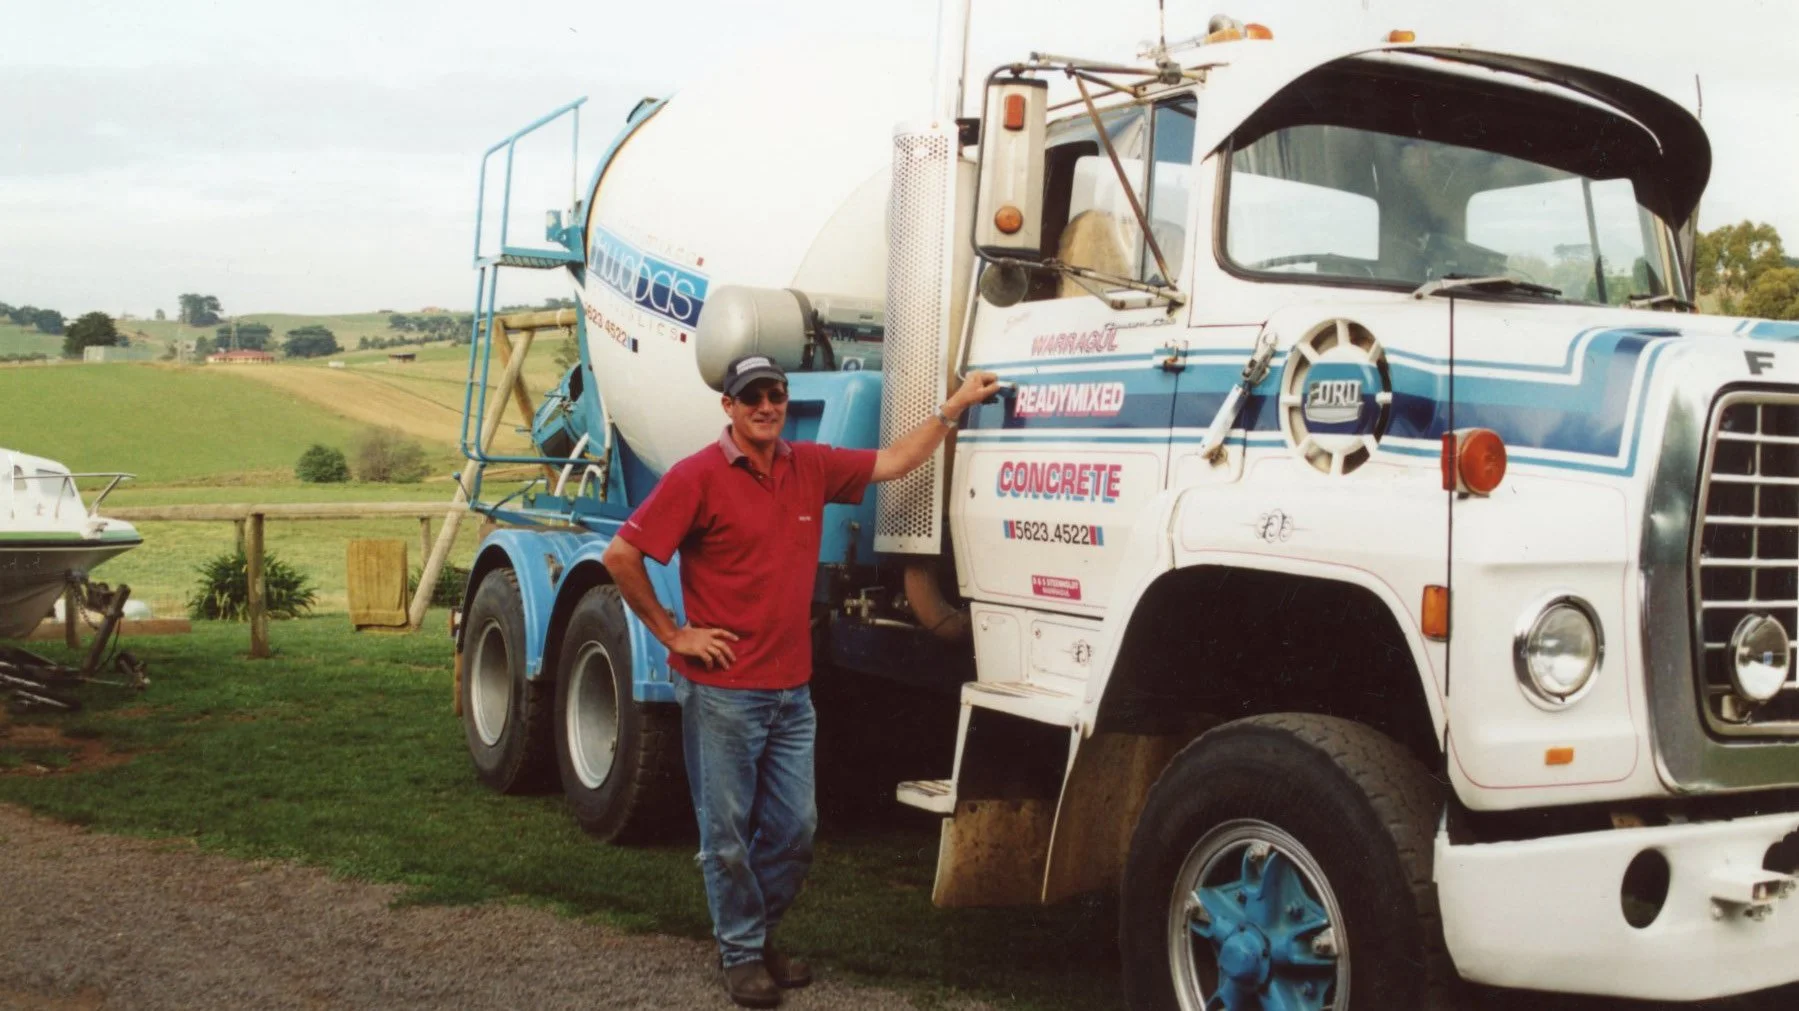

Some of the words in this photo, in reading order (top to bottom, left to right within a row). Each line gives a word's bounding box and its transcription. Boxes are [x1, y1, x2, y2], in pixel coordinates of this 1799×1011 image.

[1031, 329, 1119, 356] WARRAGUL
[1744, 350, 1775, 375] F
[1014, 382, 1124, 417] READYMIXED
[1308, 380, 1362, 407] FORD
[997, 461, 1122, 501] CONCRETE
